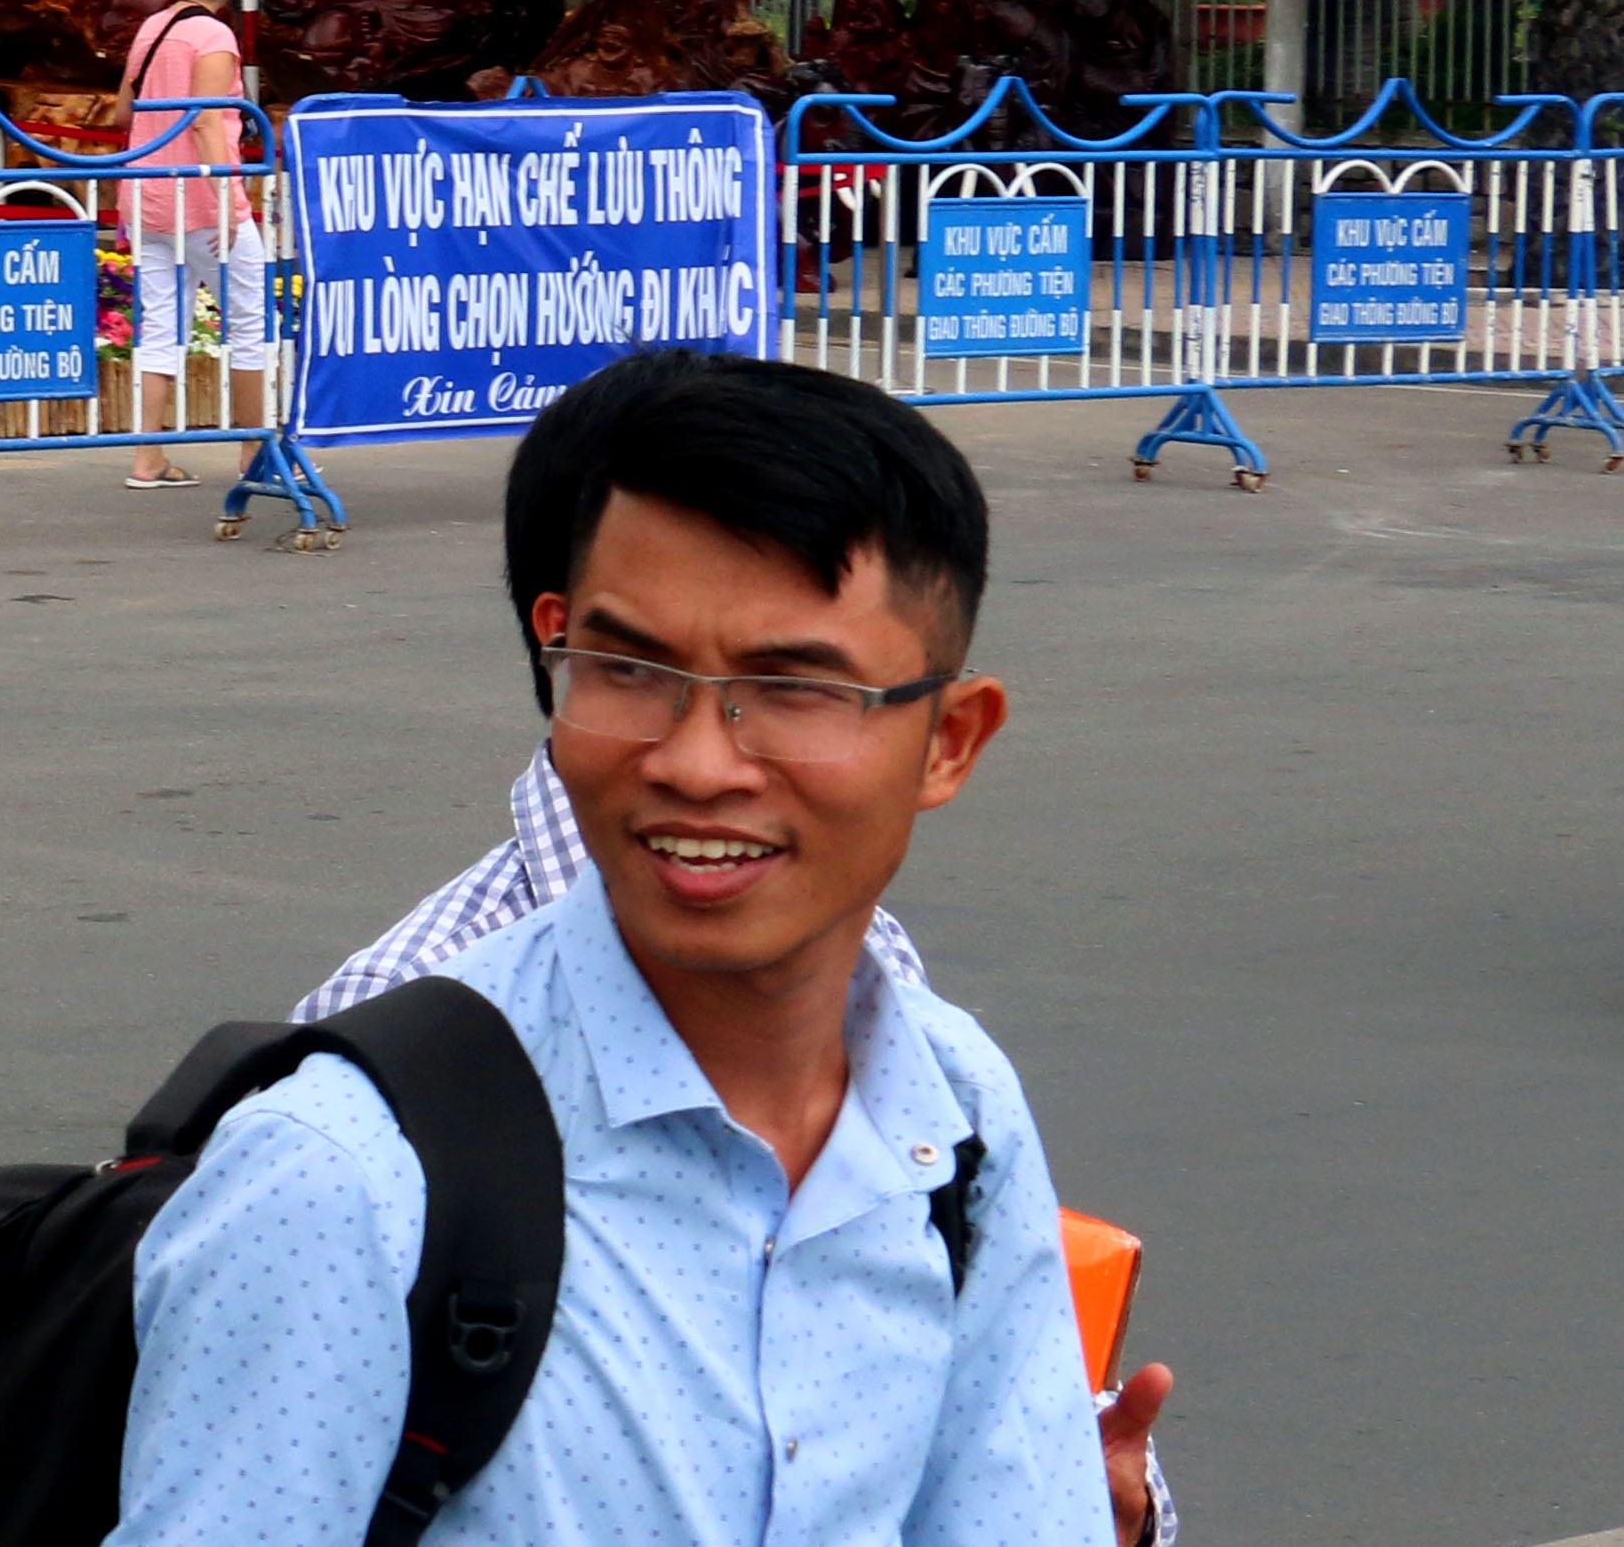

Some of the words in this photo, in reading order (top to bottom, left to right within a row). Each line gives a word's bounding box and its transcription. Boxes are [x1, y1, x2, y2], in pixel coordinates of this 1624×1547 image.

[317, 154, 376, 234] KHU
[381, 138, 445, 247] VỰC
[450, 152, 513, 245] HẠN
[517, 121, 583, 227] CHẾ
[587, 135, 645, 226] LƯU
[649, 127, 743, 223] THÔNG
[944, 225, 982, 256] KHU
[986, 221, 1023, 262] VỰC
[1027, 213, 1069, 255] CẤM
[1336, 219, 1371, 247] KHU
[1374, 214, 1409, 252] VỰC
[1411, 209, 1449, 247] CẤM
[4, 239, 60, 286] CẤM
[934, 266, 966, 297] CÁC
[971, 269, 1033, 297] PHƯƠNG
[1038, 265, 1075, 300] TIỆN
[1326, 257, 1358, 287] CÁC
[1360, 260, 1418, 286] PHƯƠNG
[1420, 257, 1455, 290] TIỆN
[22, 299, 73, 336] TIỆN
[316, 279, 355, 357] VUI
[362, 255, 441, 354] LÒNG
[447, 272, 529, 366] CHỌN
[535, 250, 635, 346] HƯỚNG
[639, 268, 671, 342] ĐI
[928, 315, 960, 341] GIAO
[962, 308, 1007, 339] THÔNG
[1009, 307, 1056, 338] ĐƯỜNG
[1059, 306, 1079, 341] BỘ
[57, 344, 84, 383] BỘ
[402, 375, 478, 417] Xin
